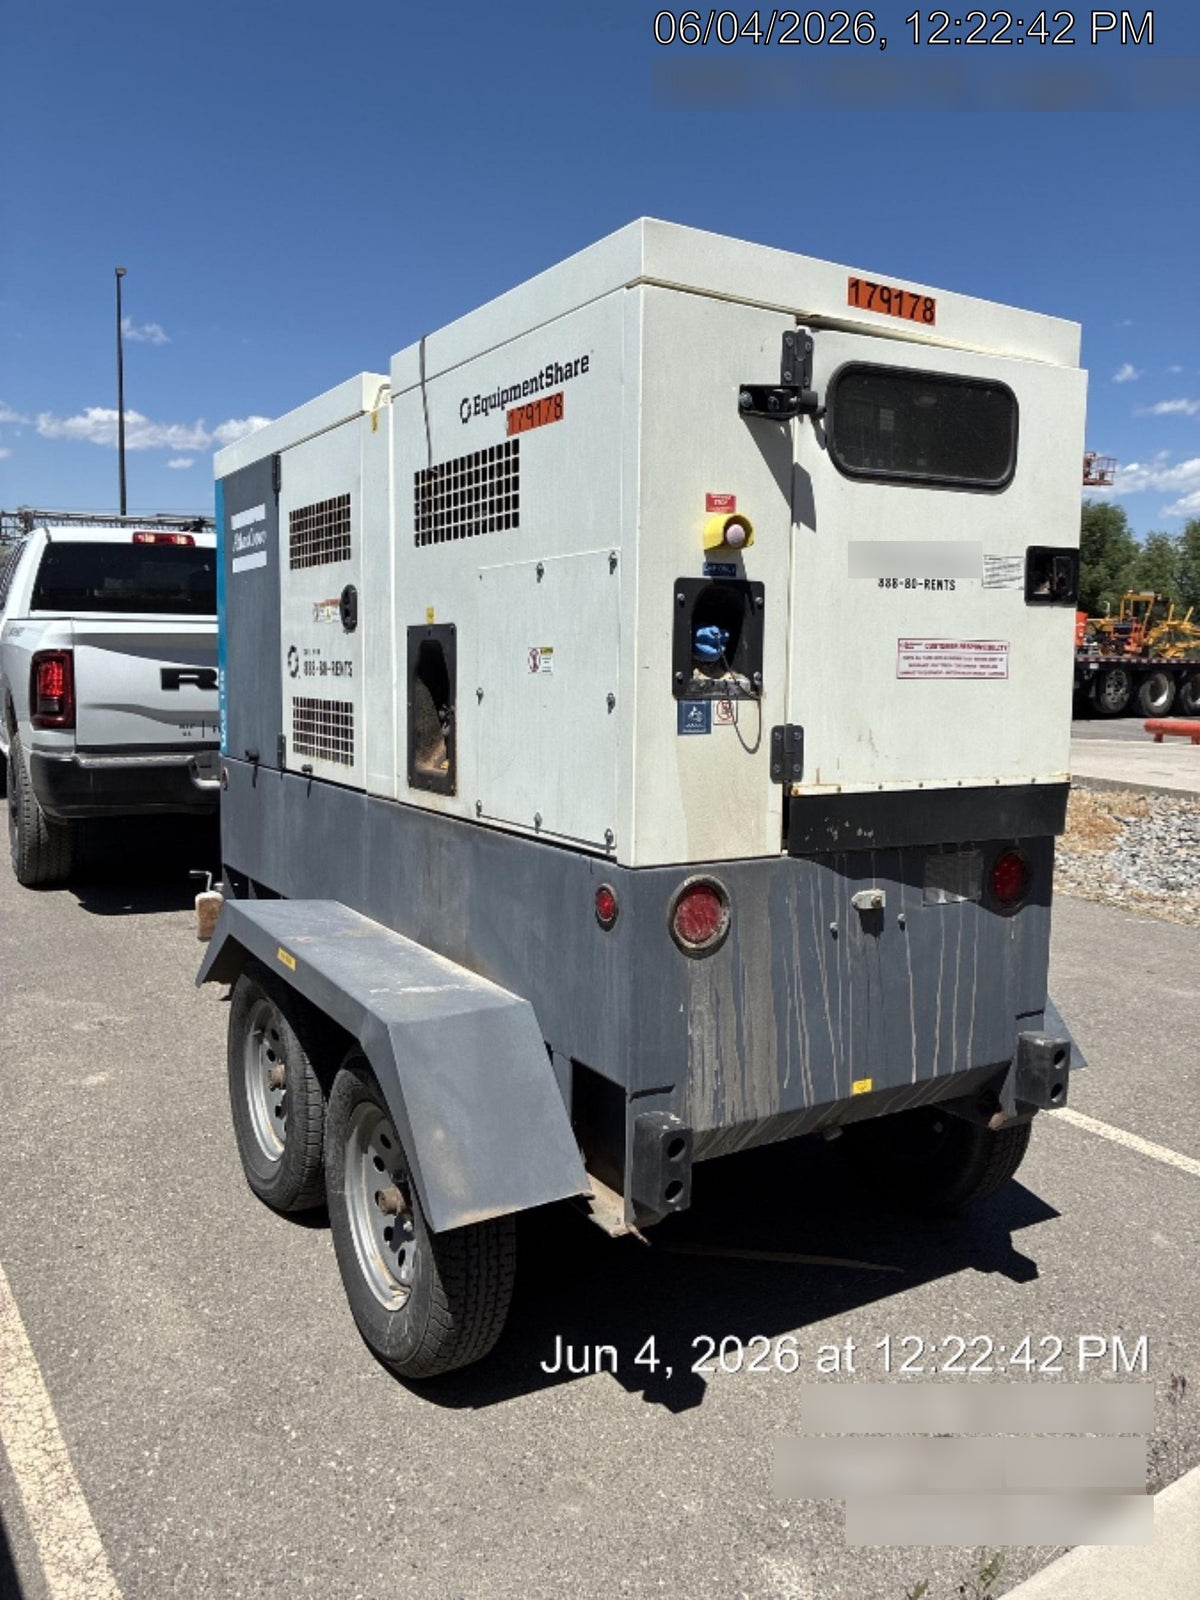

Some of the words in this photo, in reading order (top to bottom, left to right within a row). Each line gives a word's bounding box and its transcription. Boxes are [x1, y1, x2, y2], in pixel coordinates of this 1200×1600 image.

[850, 278, 935, 323] 179178
[473, 354, 590, 417] EquipmentShare
[508, 393, 564, 433] 179178
